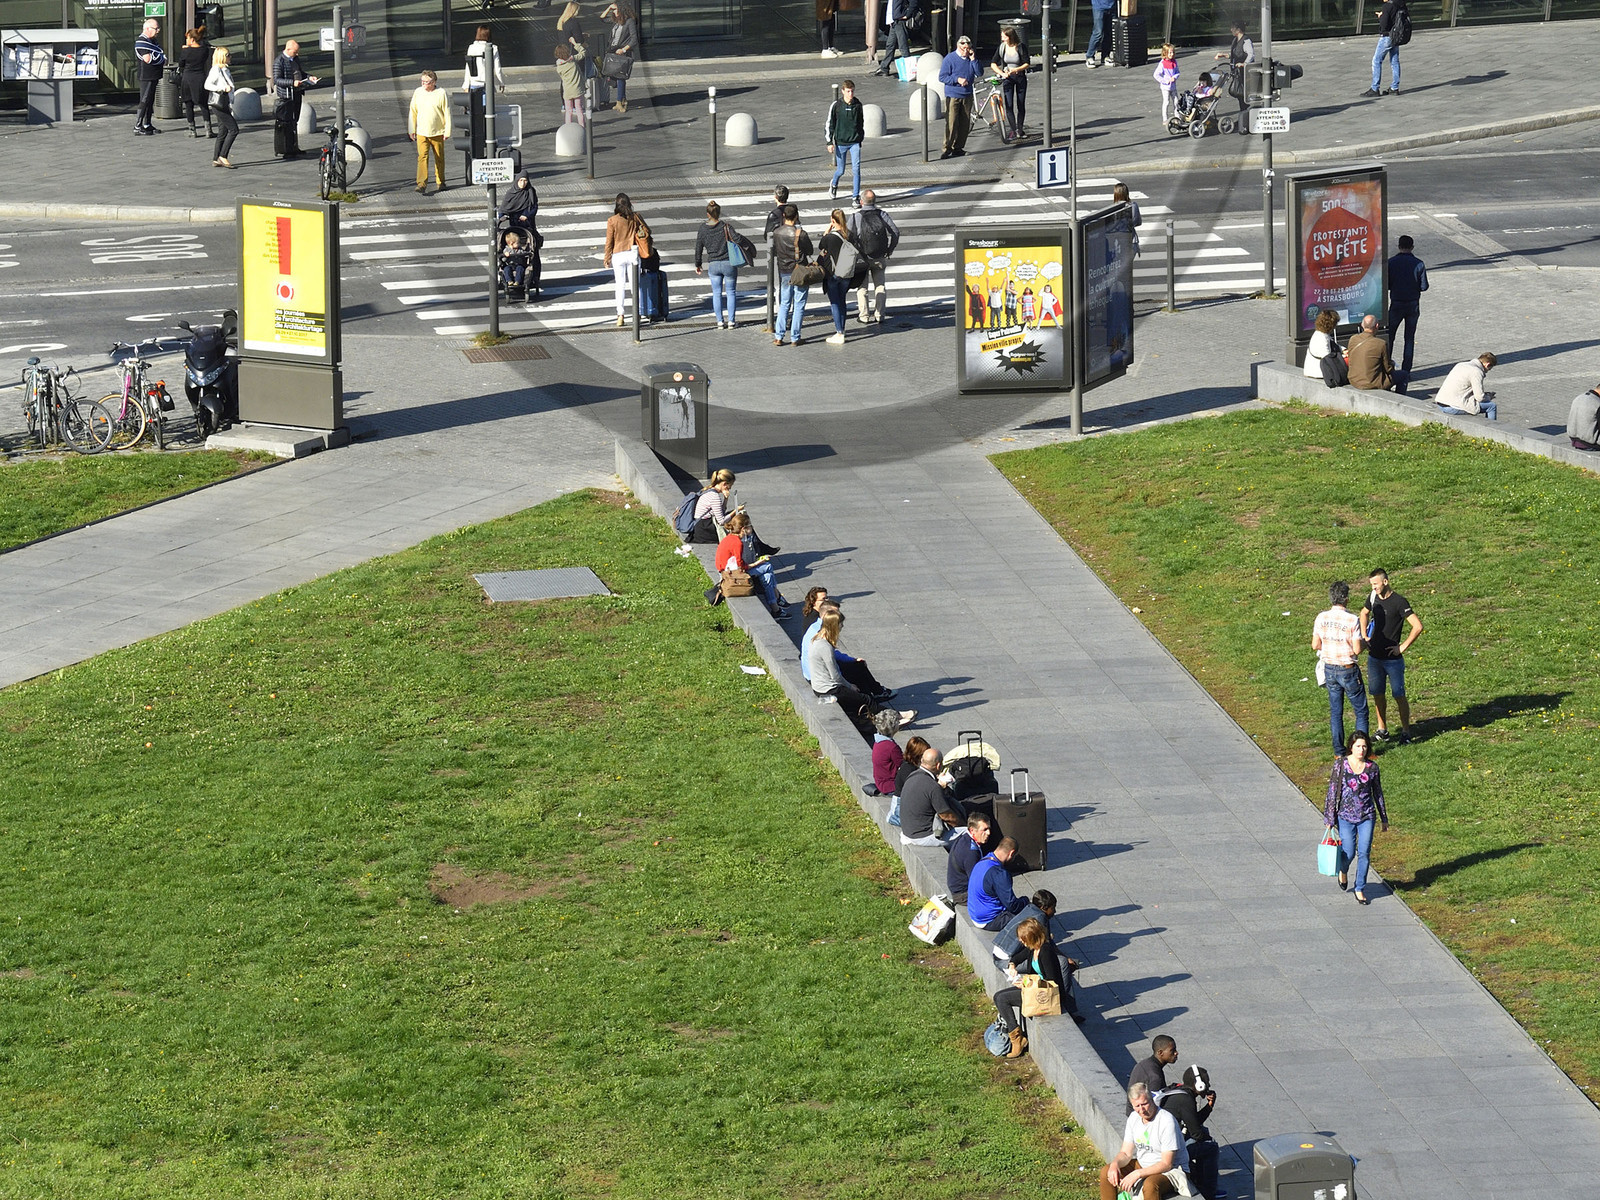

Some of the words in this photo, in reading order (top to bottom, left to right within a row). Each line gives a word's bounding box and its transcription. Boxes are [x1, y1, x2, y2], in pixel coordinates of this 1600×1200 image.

[1322, 199, 1340, 212] 500
[1313, 226, 1368, 241] PROTESTANTS
[80, 234, 208, 264] BUS
[1313, 242, 1332, 260] EN
[1336, 238, 1367, 260] FÊTE
[1088, 259, 1120, 280] Rencontrez
[1089, 283, 1094, 295] la
[1095, 277, 1116, 293] culture
[1345, 282, 1368, 292] OCTOBRE
[1322, 290, 1364, 303] STRASBOURG
[982, 342, 998, 351] Mission
[1009, 337, 1021, 346] propre
